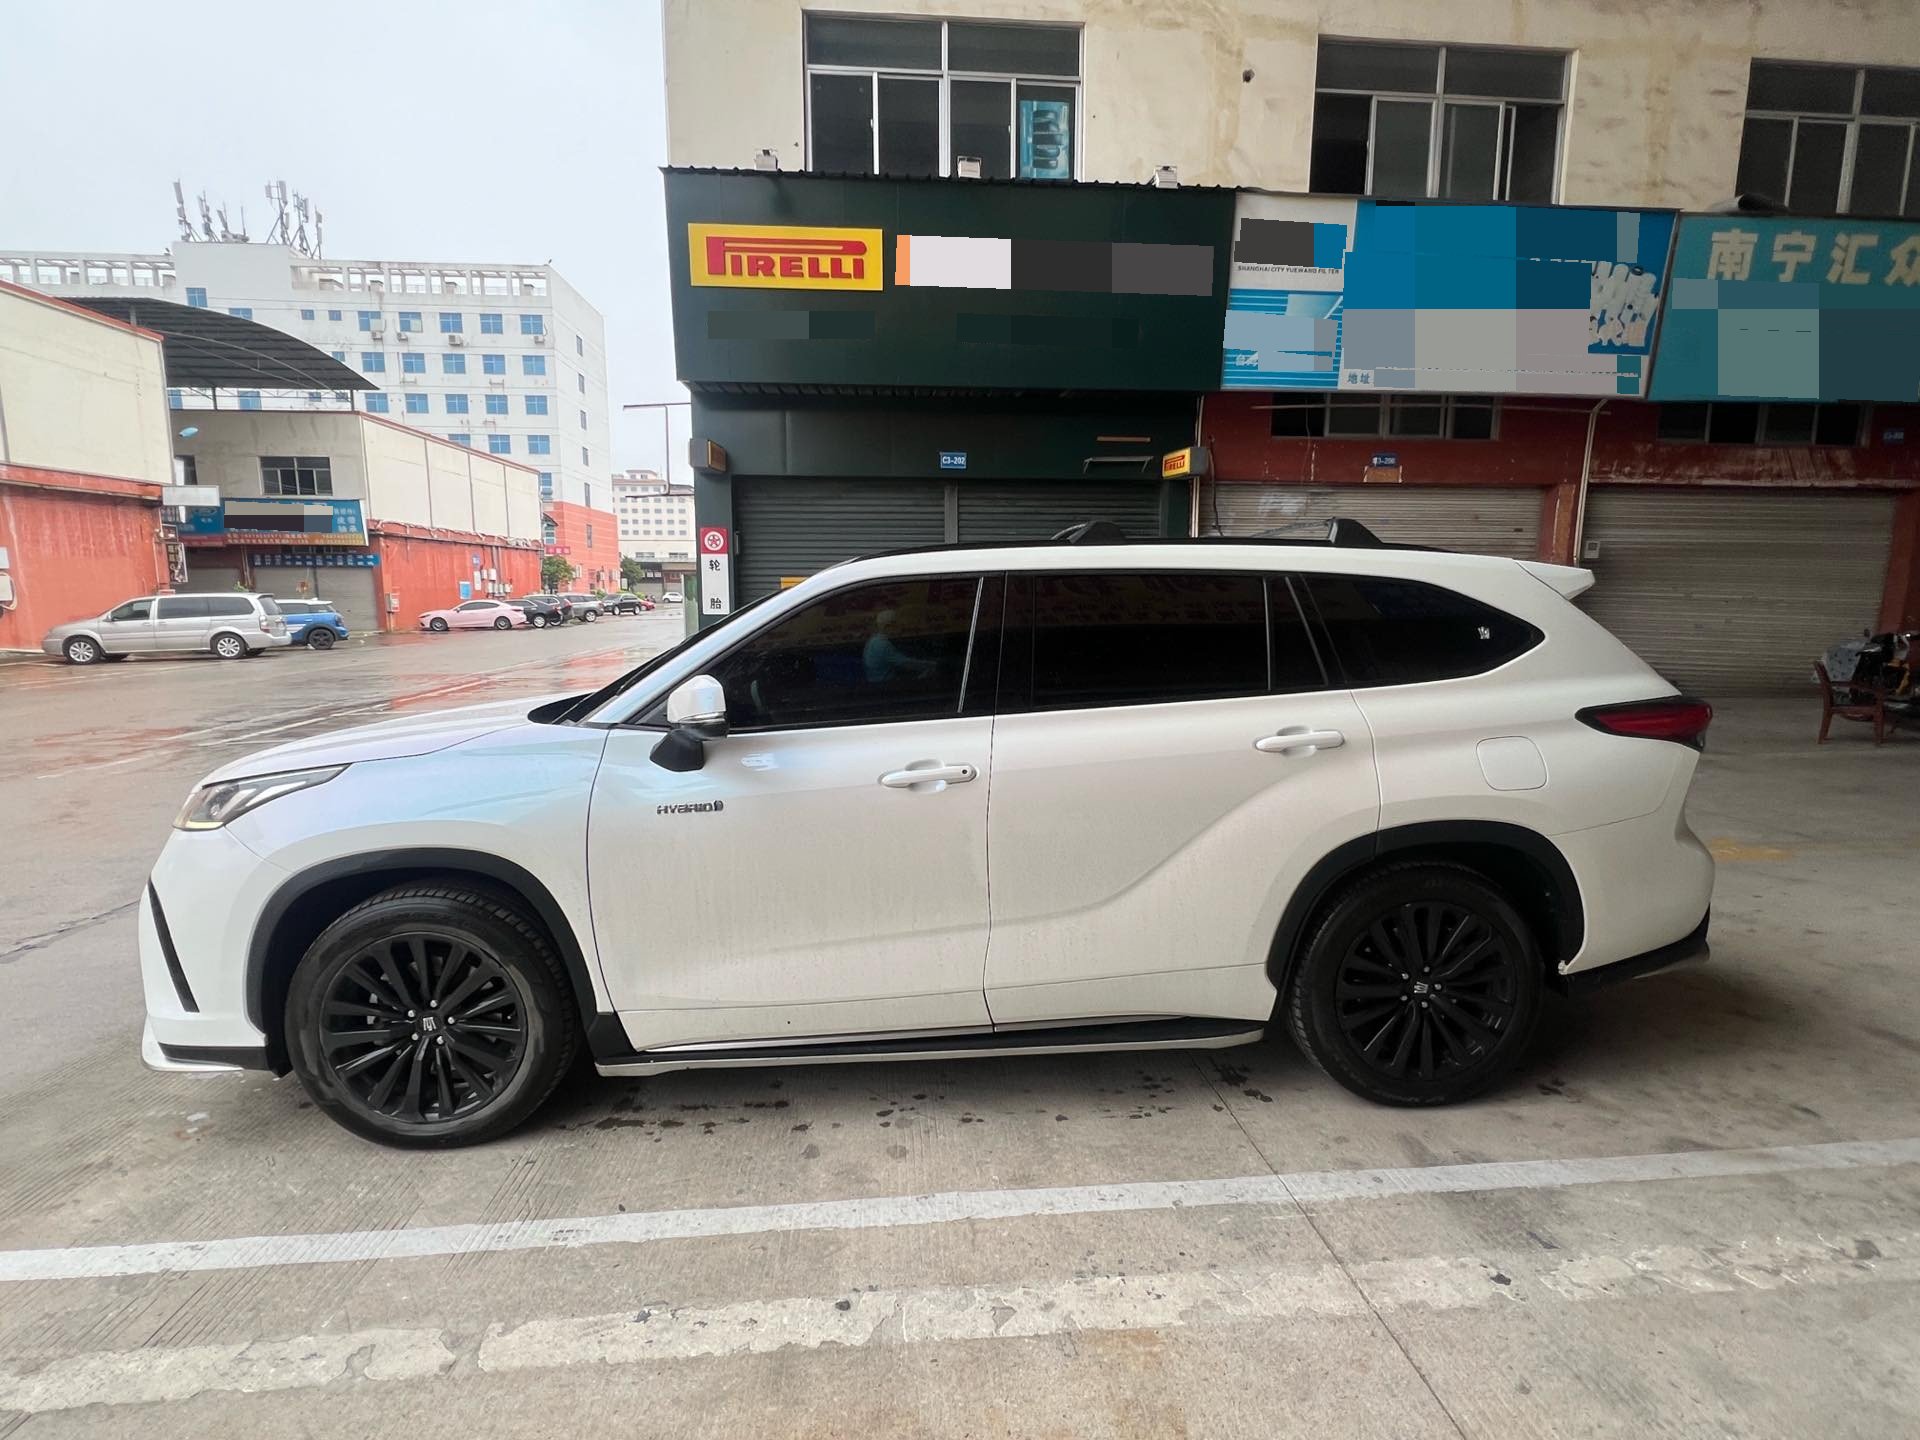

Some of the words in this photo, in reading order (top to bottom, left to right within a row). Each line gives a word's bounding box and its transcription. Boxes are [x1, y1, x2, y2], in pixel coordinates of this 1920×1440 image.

[706, 236, 867, 280] PIRELLI
[1238, 265, 1270, 273] SHANGHAI
[1707, 228, 1920, 286] 南宁汇众
[1348, 373, 1370, 385] 地址
[942, 456, 966, 465] C3-202
[709, 559, 722, 610] 轮胎
